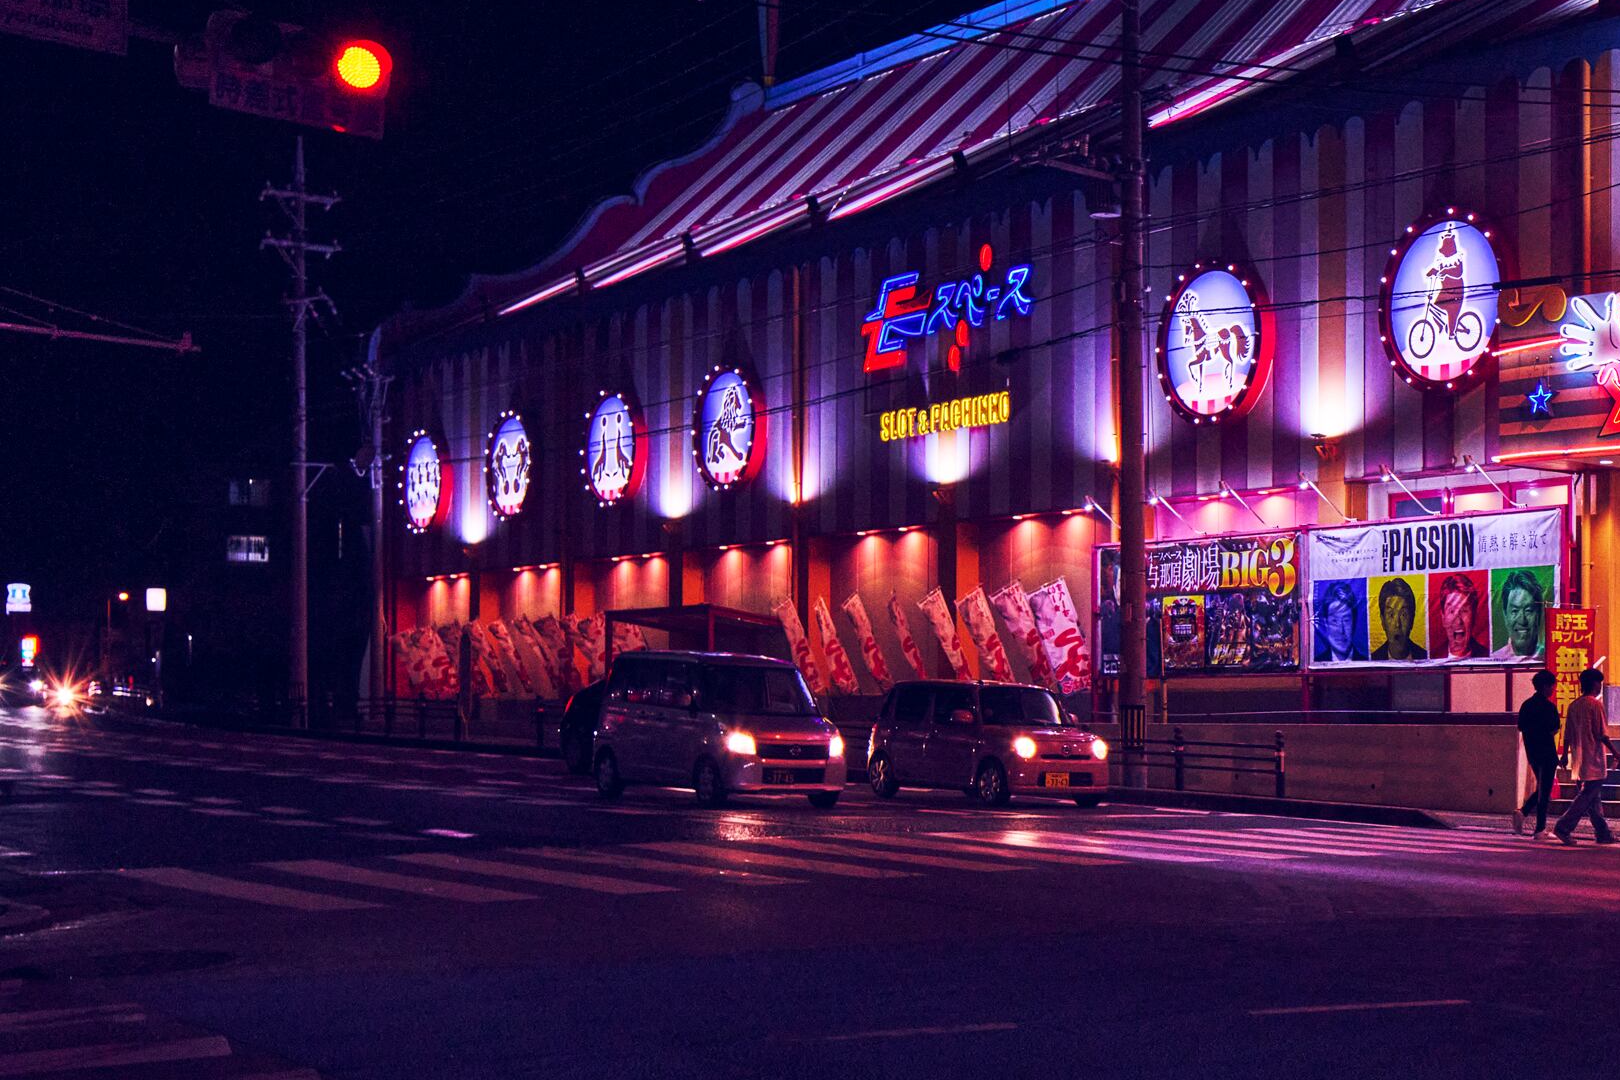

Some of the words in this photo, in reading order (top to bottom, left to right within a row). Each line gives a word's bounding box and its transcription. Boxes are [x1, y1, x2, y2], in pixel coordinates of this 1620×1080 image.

[880, 407, 917, 441] SLOT
[918, 409, 930, 436] &
[930, 390, 1010, 434] PACHINKO
[1389, 523, 1474, 572] PASSION
[1478, 531, 1547, 552] 情熱を解き放て
[1147, 546, 1221, 591] 与那原劇場
[1220, 537, 1296, 597] BIG3
[1551, 631, 1594, 643] 再プレイ
[1555, 613, 1588, 630] 貯玉
